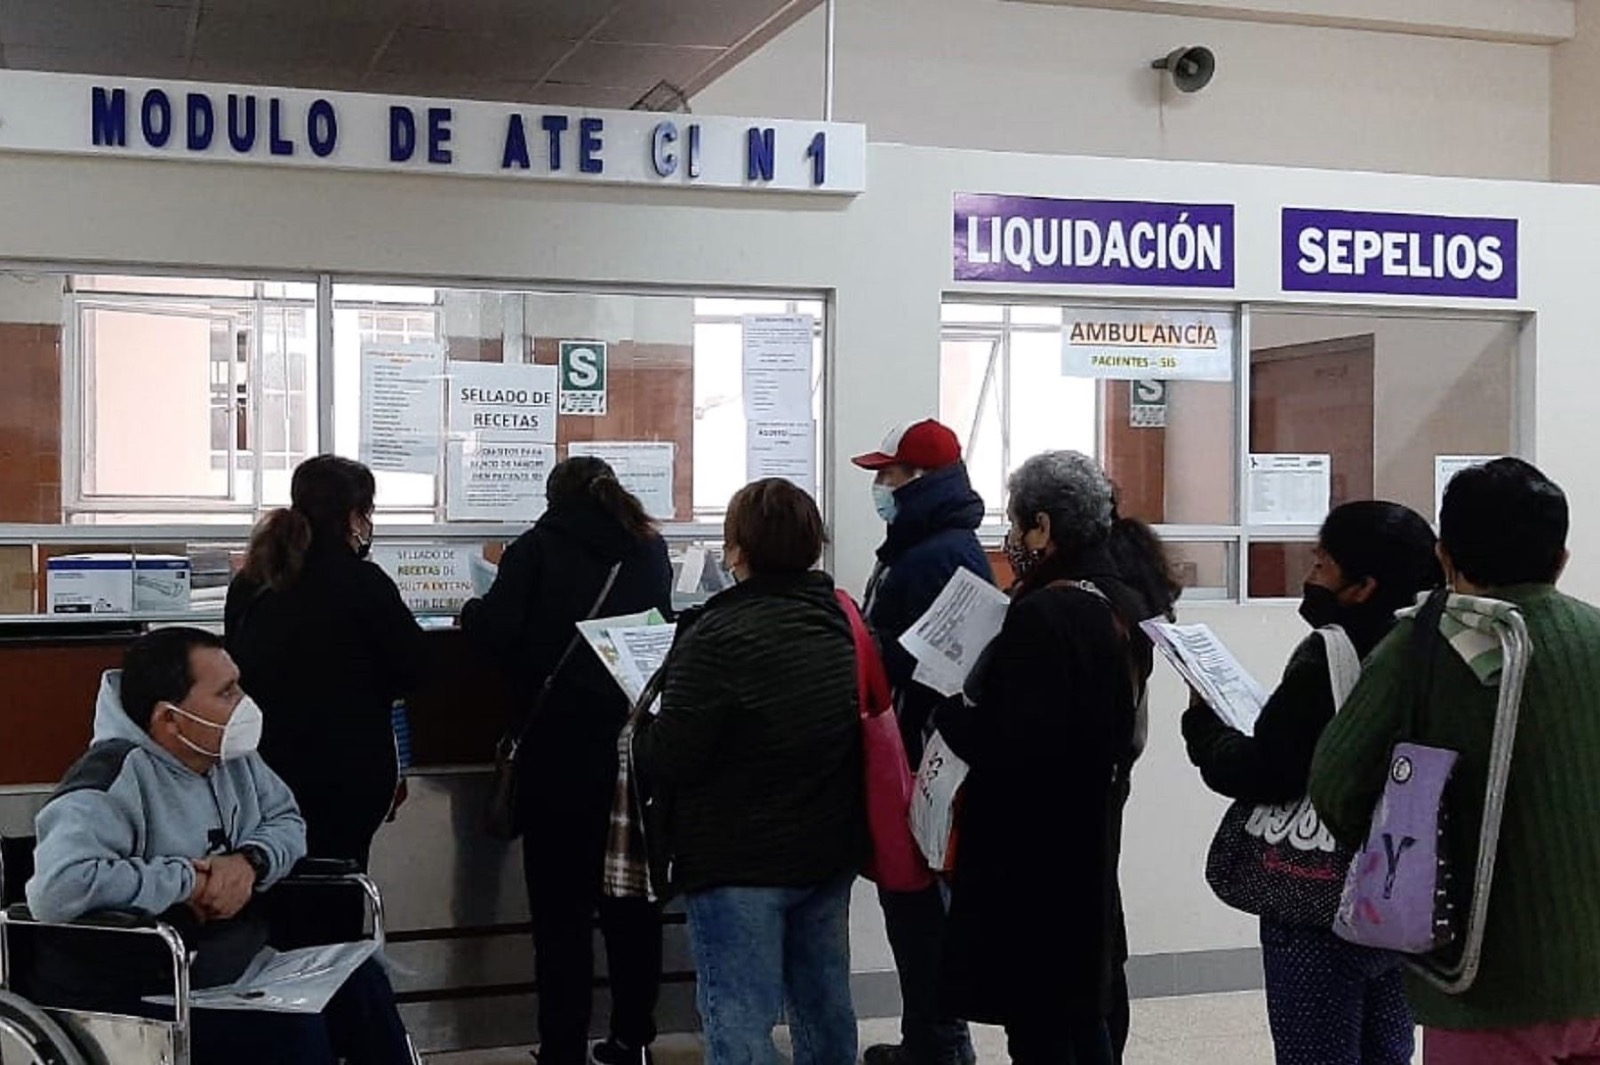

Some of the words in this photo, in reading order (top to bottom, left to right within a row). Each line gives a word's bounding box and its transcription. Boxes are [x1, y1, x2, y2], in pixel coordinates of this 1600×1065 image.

[92, 86, 337, 157] MODULO
[390, 106, 452, 163] DE
[807, 132, 826, 185] 1
[967, 212, 1222, 272] LIQUIDACIÓN
[1298, 227, 1503, 281] SEPELIOS
[569, 348, 598, 387] S
[1092, 355, 1148, 368] PACIENTES
[1160, 357, 1177, 368] SIS
[461, 388, 528, 404] SELLADO
[533, 391, 552, 404] DE
[474, 413, 539, 428] RECETAS
[398, 565, 440, 576] RECETAS
